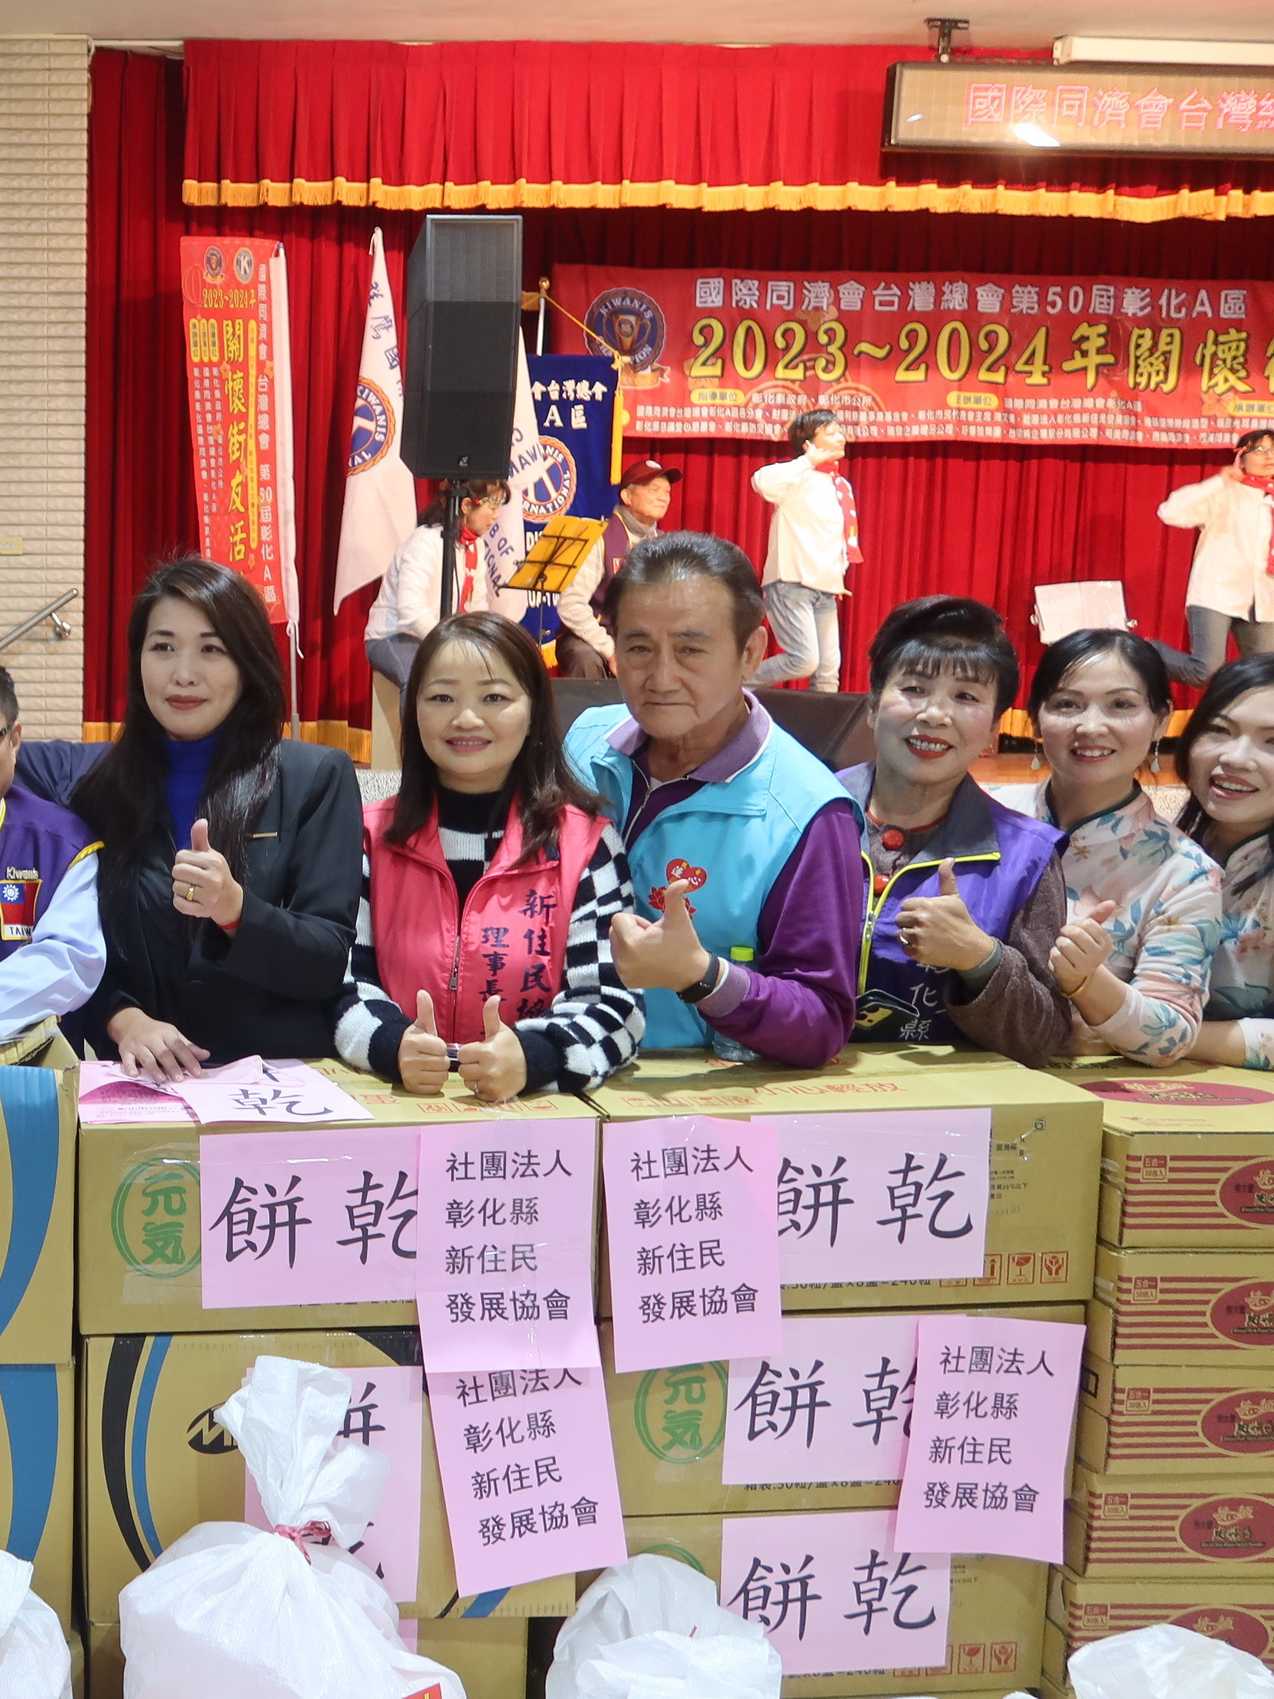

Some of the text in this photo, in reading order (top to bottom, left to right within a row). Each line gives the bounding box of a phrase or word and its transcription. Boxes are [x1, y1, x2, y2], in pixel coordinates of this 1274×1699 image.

[599, 297, 653, 318] KIWANIS
[694, 276, 1247, 319] 國際同濟會台灣總會第50屆彰化A區
[223, 319, 248, 580] 關懷街友活
[445, 1149, 573, 1182] 社團法人
[630, 1144, 754, 1182] 社團法人
[444, 1196, 540, 1230] 彰化縣
[633, 1191, 724, 1230] 彰化縣
[777, 1152, 974, 1248] 餅乾
[444, 1242, 539, 1276] 新住民
[636, 1239, 726, 1277] 新住民
[445, 1288, 572, 1324] 發展協會
[638, 1283, 760, 1324] 發展協會
[938, 1345, 1056, 1378] 社團法人
[456, 1368, 583, 1409] 社團法人
[933, 1390, 1020, 1421] 彰化縣
[462, 1409, 559, 1455] 彰化縣
[928, 1436, 1013, 1466] 新住民
[470, 1455, 564, 1501] 新住民
[923, 1481, 1041, 1513] 發展協會
[477, 1496, 600, 1547] 發展協會
[726, 1548, 937, 1642] 餅乾
